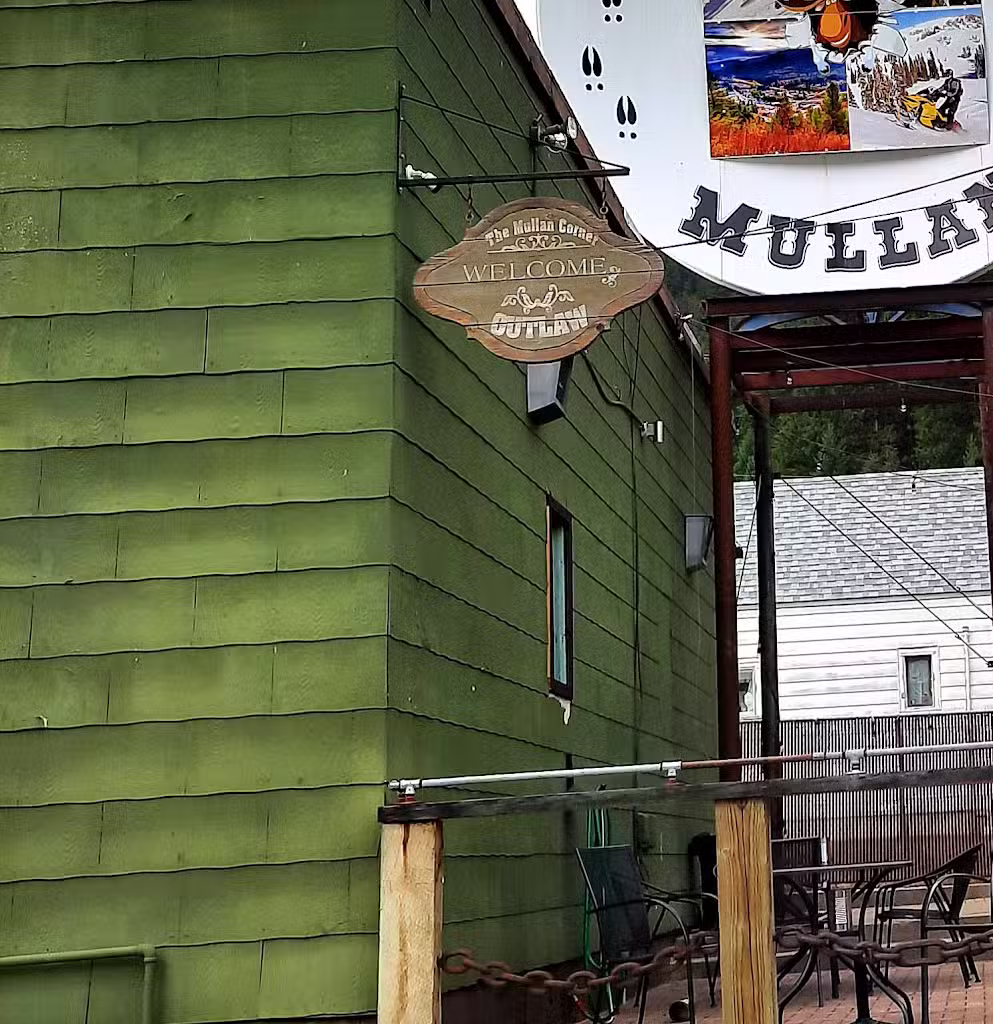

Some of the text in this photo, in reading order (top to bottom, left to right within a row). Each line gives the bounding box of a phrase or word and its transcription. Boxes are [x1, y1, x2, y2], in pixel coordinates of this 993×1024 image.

[485, 217, 599, 247] The Mullan Corner
[463, 257, 607, 282] WELCOME
[490, 304, 589, 339] OUTLAW
